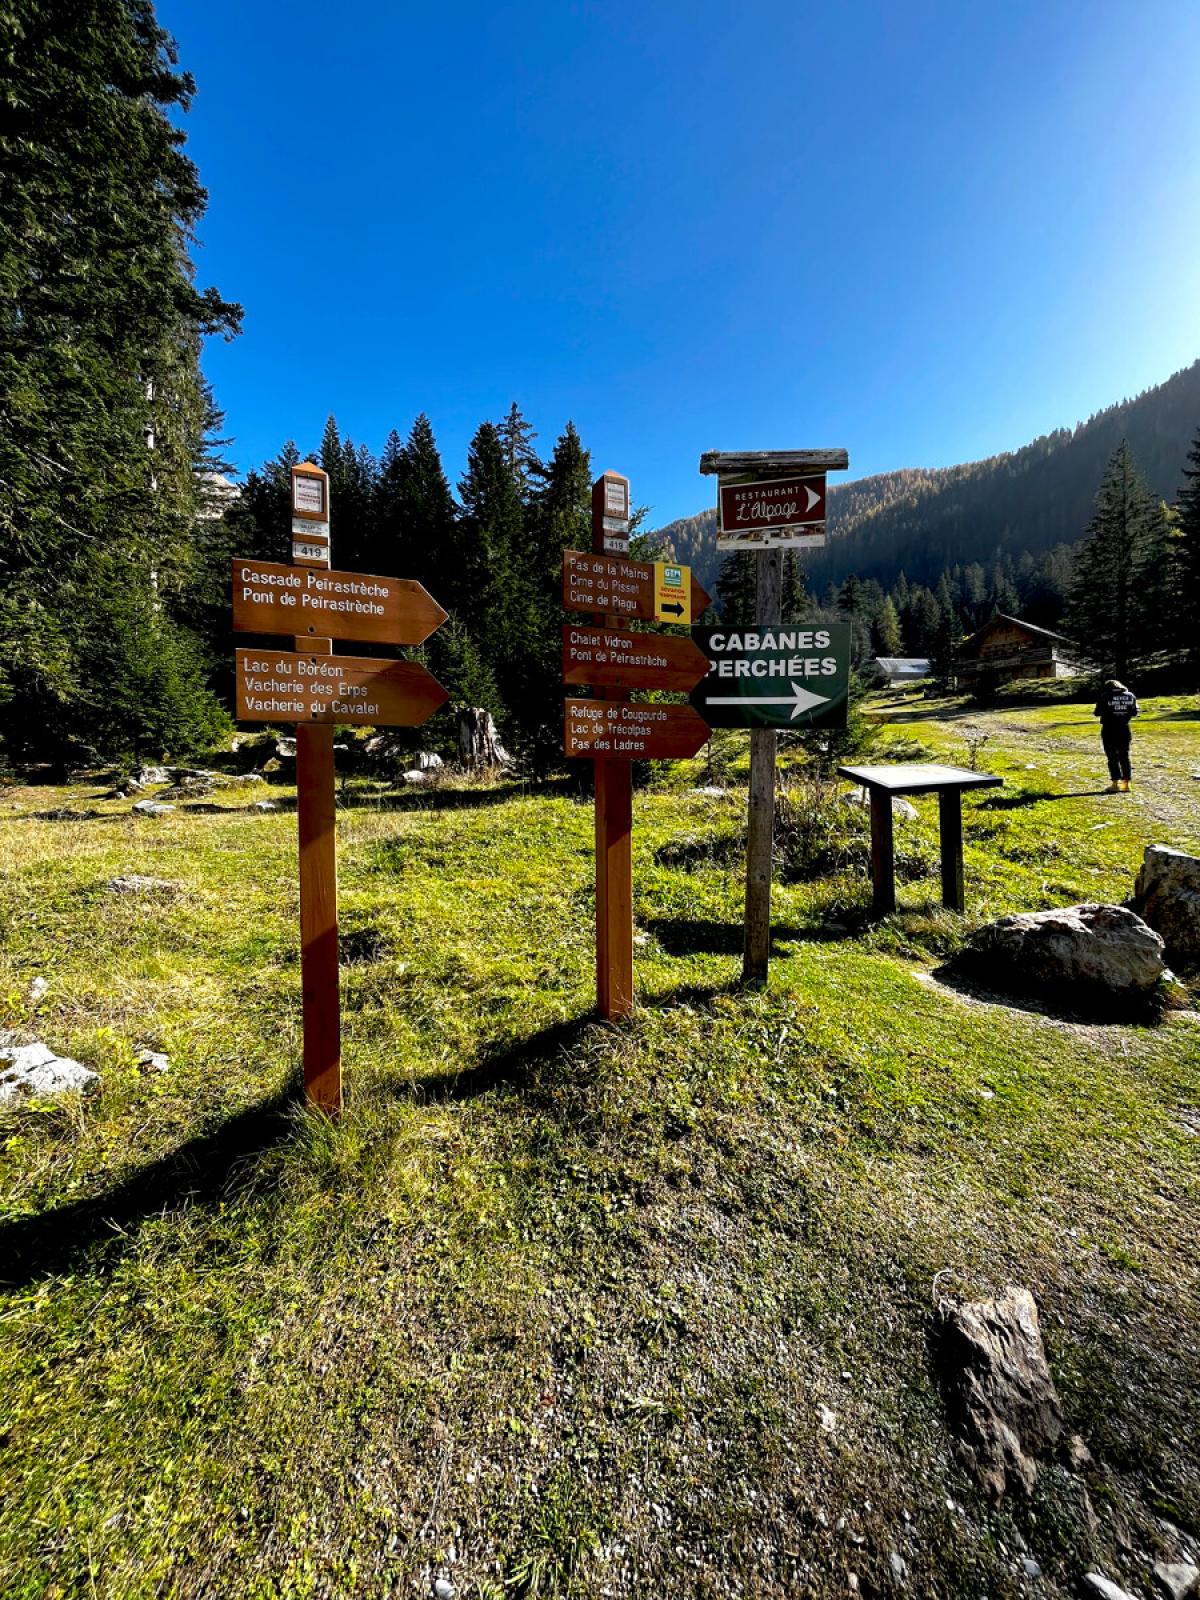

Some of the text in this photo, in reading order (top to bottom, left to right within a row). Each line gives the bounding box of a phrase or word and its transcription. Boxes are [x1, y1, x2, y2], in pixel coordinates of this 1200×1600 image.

[735, 486, 799, 501] RESTAURANT
[736, 501, 800, 522] L'Alpage
[301, 547, 321, 557] 419
[609, 541, 623, 550] 419
[569, 558, 589, 572] Pas
[592, 562, 604, 574] de
[607, 563, 617, 576] la
[241, 567, 302, 588] Cascade
[570, 574, 593, 588] Cime
[597, 579, 609, 591] du
[243, 587, 275, 605] Pont
[280, 592, 297, 606] de
[570, 590, 637, 612] Cime de Piagu
[570, 631, 633, 649] Chalet Vidron
[709, 631, 830, 651] CABANES
[570, 647, 592, 661] Pont
[595, 650, 607, 662] de
[243, 657, 344, 677] Lac du Boréon
[244, 676, 368, 698] Vacherie des Erps
[244, 696, 379, 715] Vacherie du Cavalet
[571, 705, 668, 723] Refuge de Cougourde
[571, 721, 652, 737] Lac de Trécolpas
[571, 737, 645, 750] Pas des Ladres
